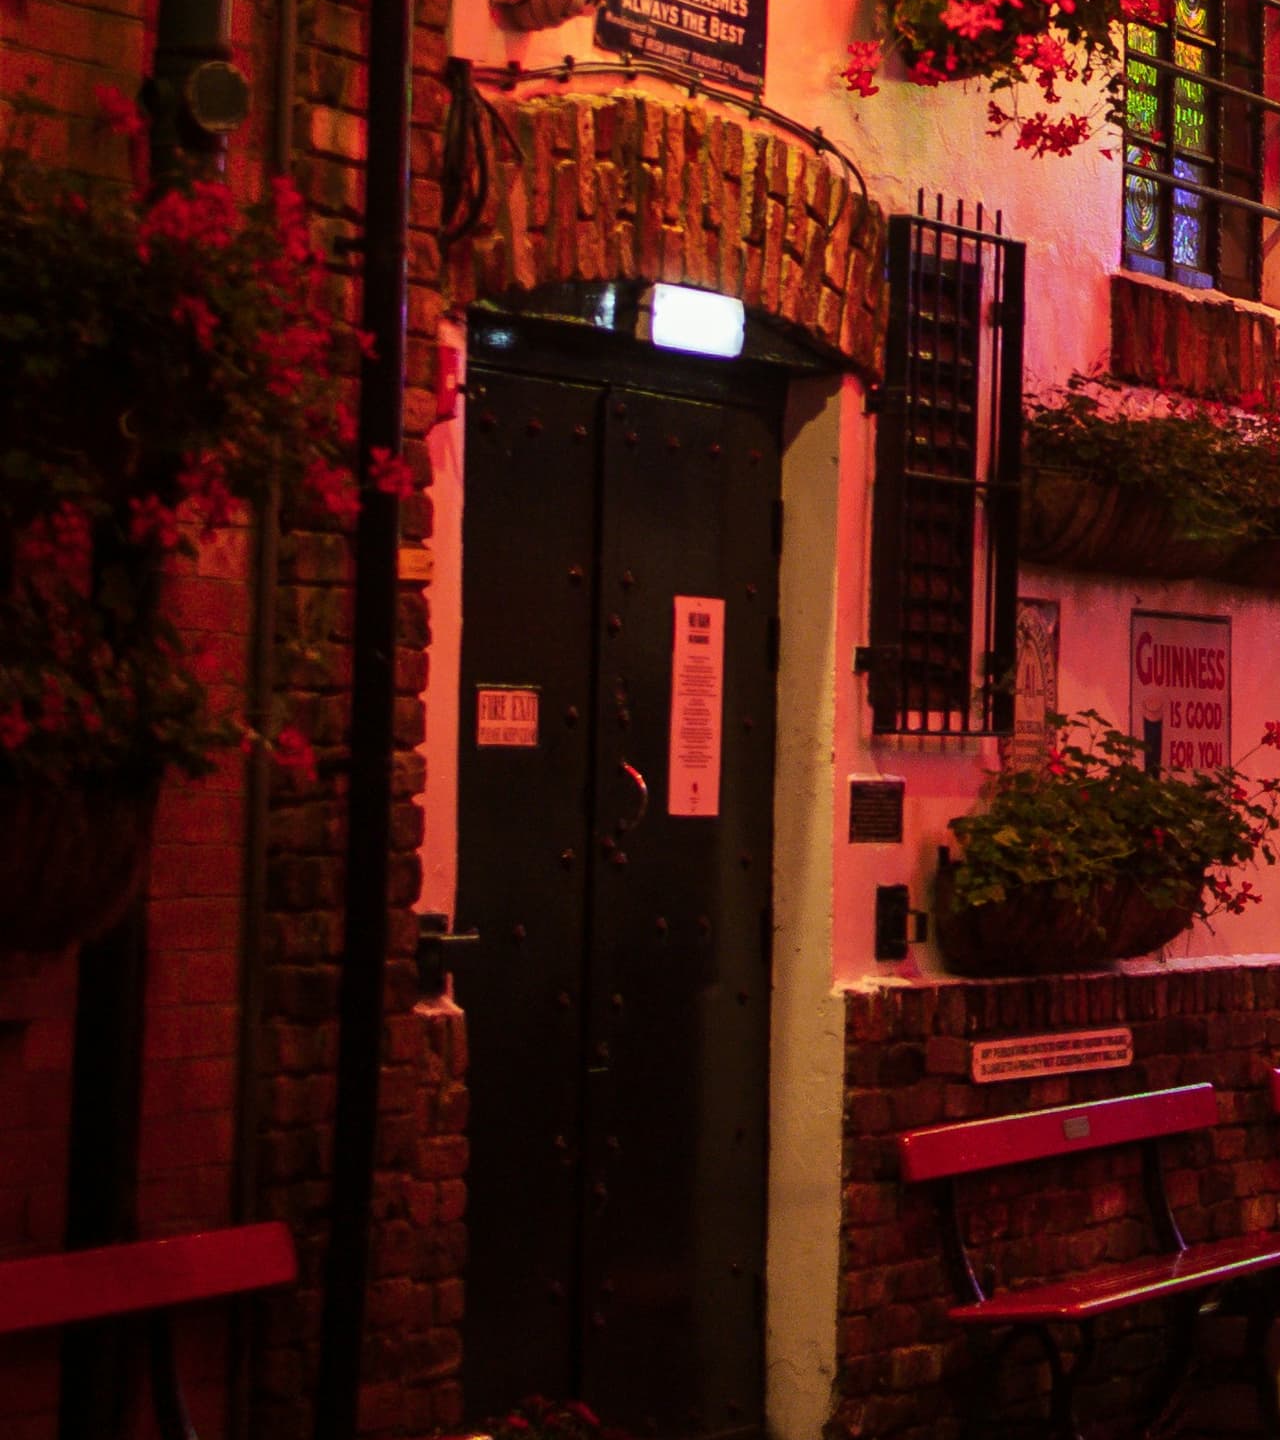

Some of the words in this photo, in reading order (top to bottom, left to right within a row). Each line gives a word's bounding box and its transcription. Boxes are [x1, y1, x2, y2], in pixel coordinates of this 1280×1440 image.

[682, 8, 707, 35] THE
[709, 15, 746, 47] BEST
[1135, 630, 1226, 691] GUINNESS
[1170, 701, 1181, 729] IS
[1186, 702, 1222, 731] GOOD
[1170, 741, 1194, 768] FOR
[1198, 741, 1223, 770] YOU
